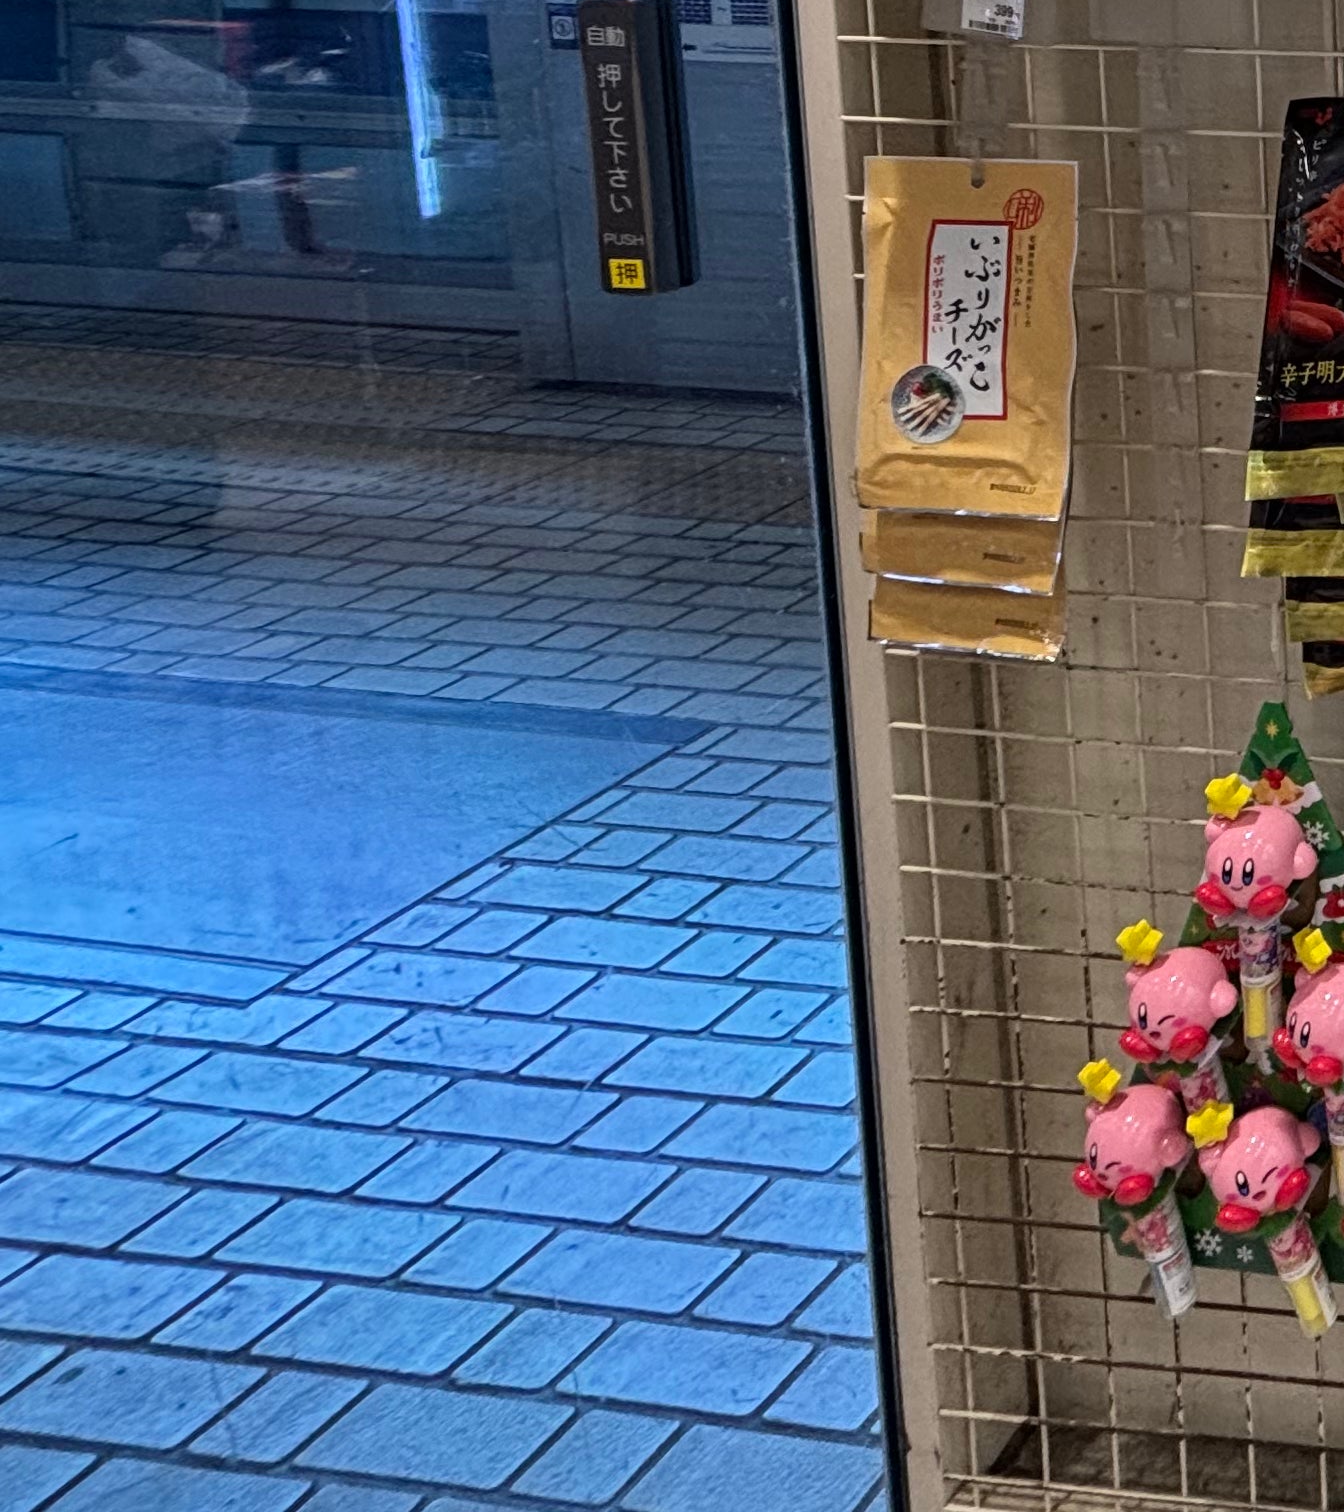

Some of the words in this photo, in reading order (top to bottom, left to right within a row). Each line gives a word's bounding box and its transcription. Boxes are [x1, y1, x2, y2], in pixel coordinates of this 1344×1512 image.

[588, 25, 626, 48] 自動
[598, 63, 633, 214] 押して下さい
[604, 233, 645, 247] PUSH
[615, 262, 638, 285] 押
[944, 299, 973, 372] チーズ
[965, 235, 1001, 392] いぶりがっこ
